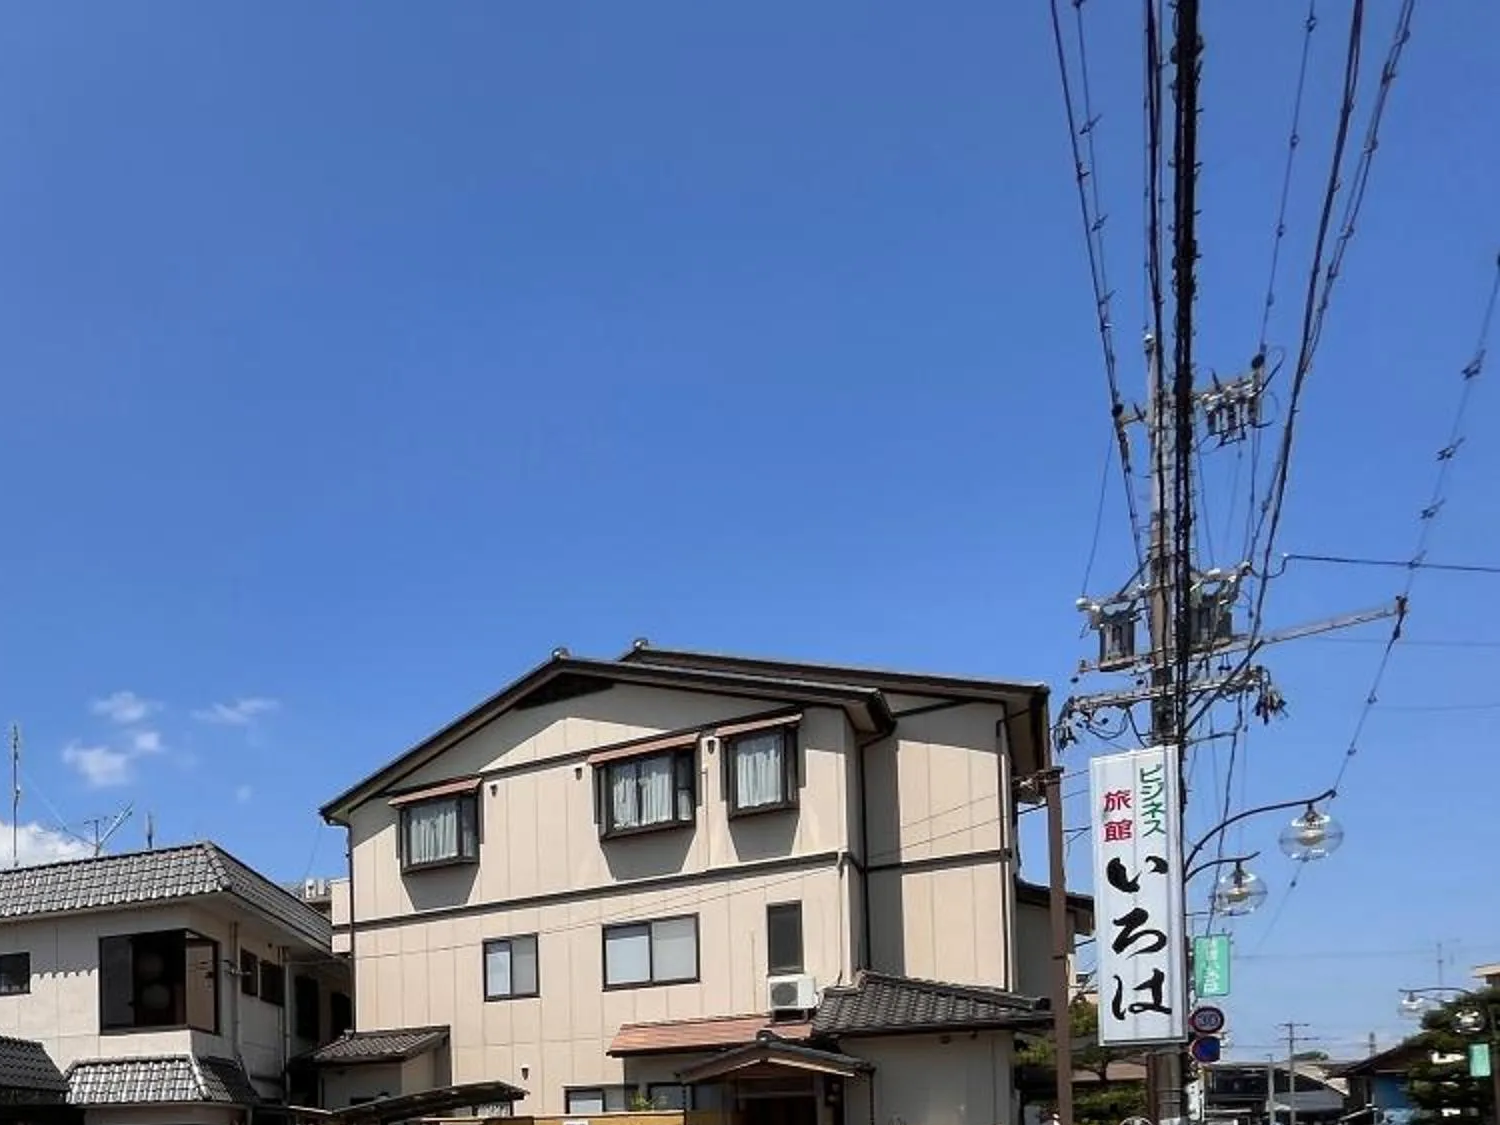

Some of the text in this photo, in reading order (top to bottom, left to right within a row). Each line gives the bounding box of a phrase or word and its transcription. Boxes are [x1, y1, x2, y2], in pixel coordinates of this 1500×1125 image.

[1103, 789, 1133, 842] 旅館
[1140, 763, 1167, 838] ビジネス
[1106, 855, 1172, 1020] いろは
